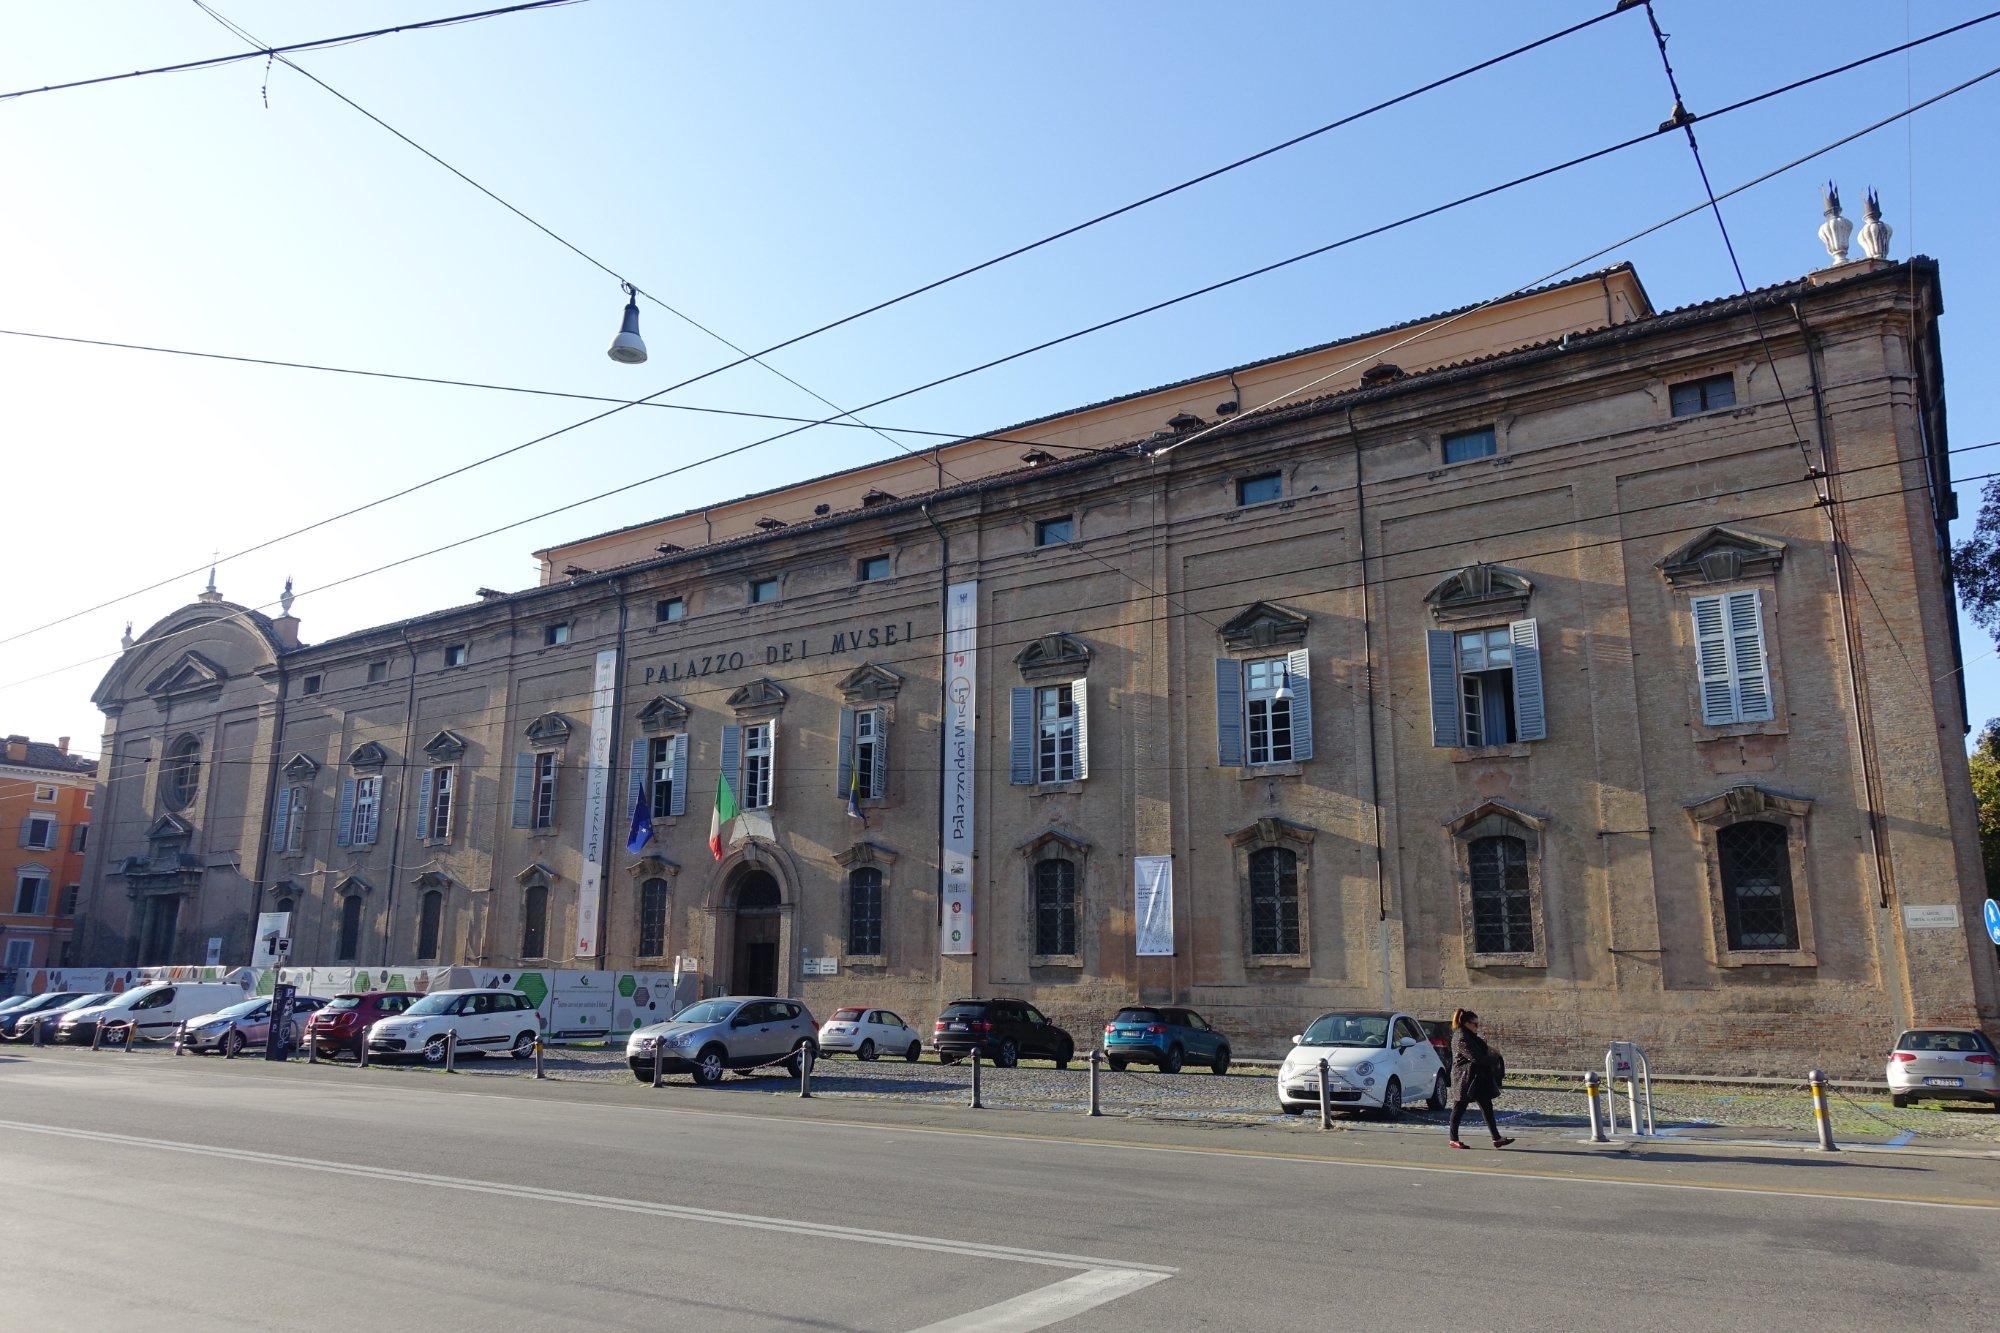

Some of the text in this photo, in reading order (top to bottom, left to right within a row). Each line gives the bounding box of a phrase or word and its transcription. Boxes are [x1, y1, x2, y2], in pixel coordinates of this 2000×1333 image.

[645, 621, 912, 685] PALAZZO DEI MVSEI
